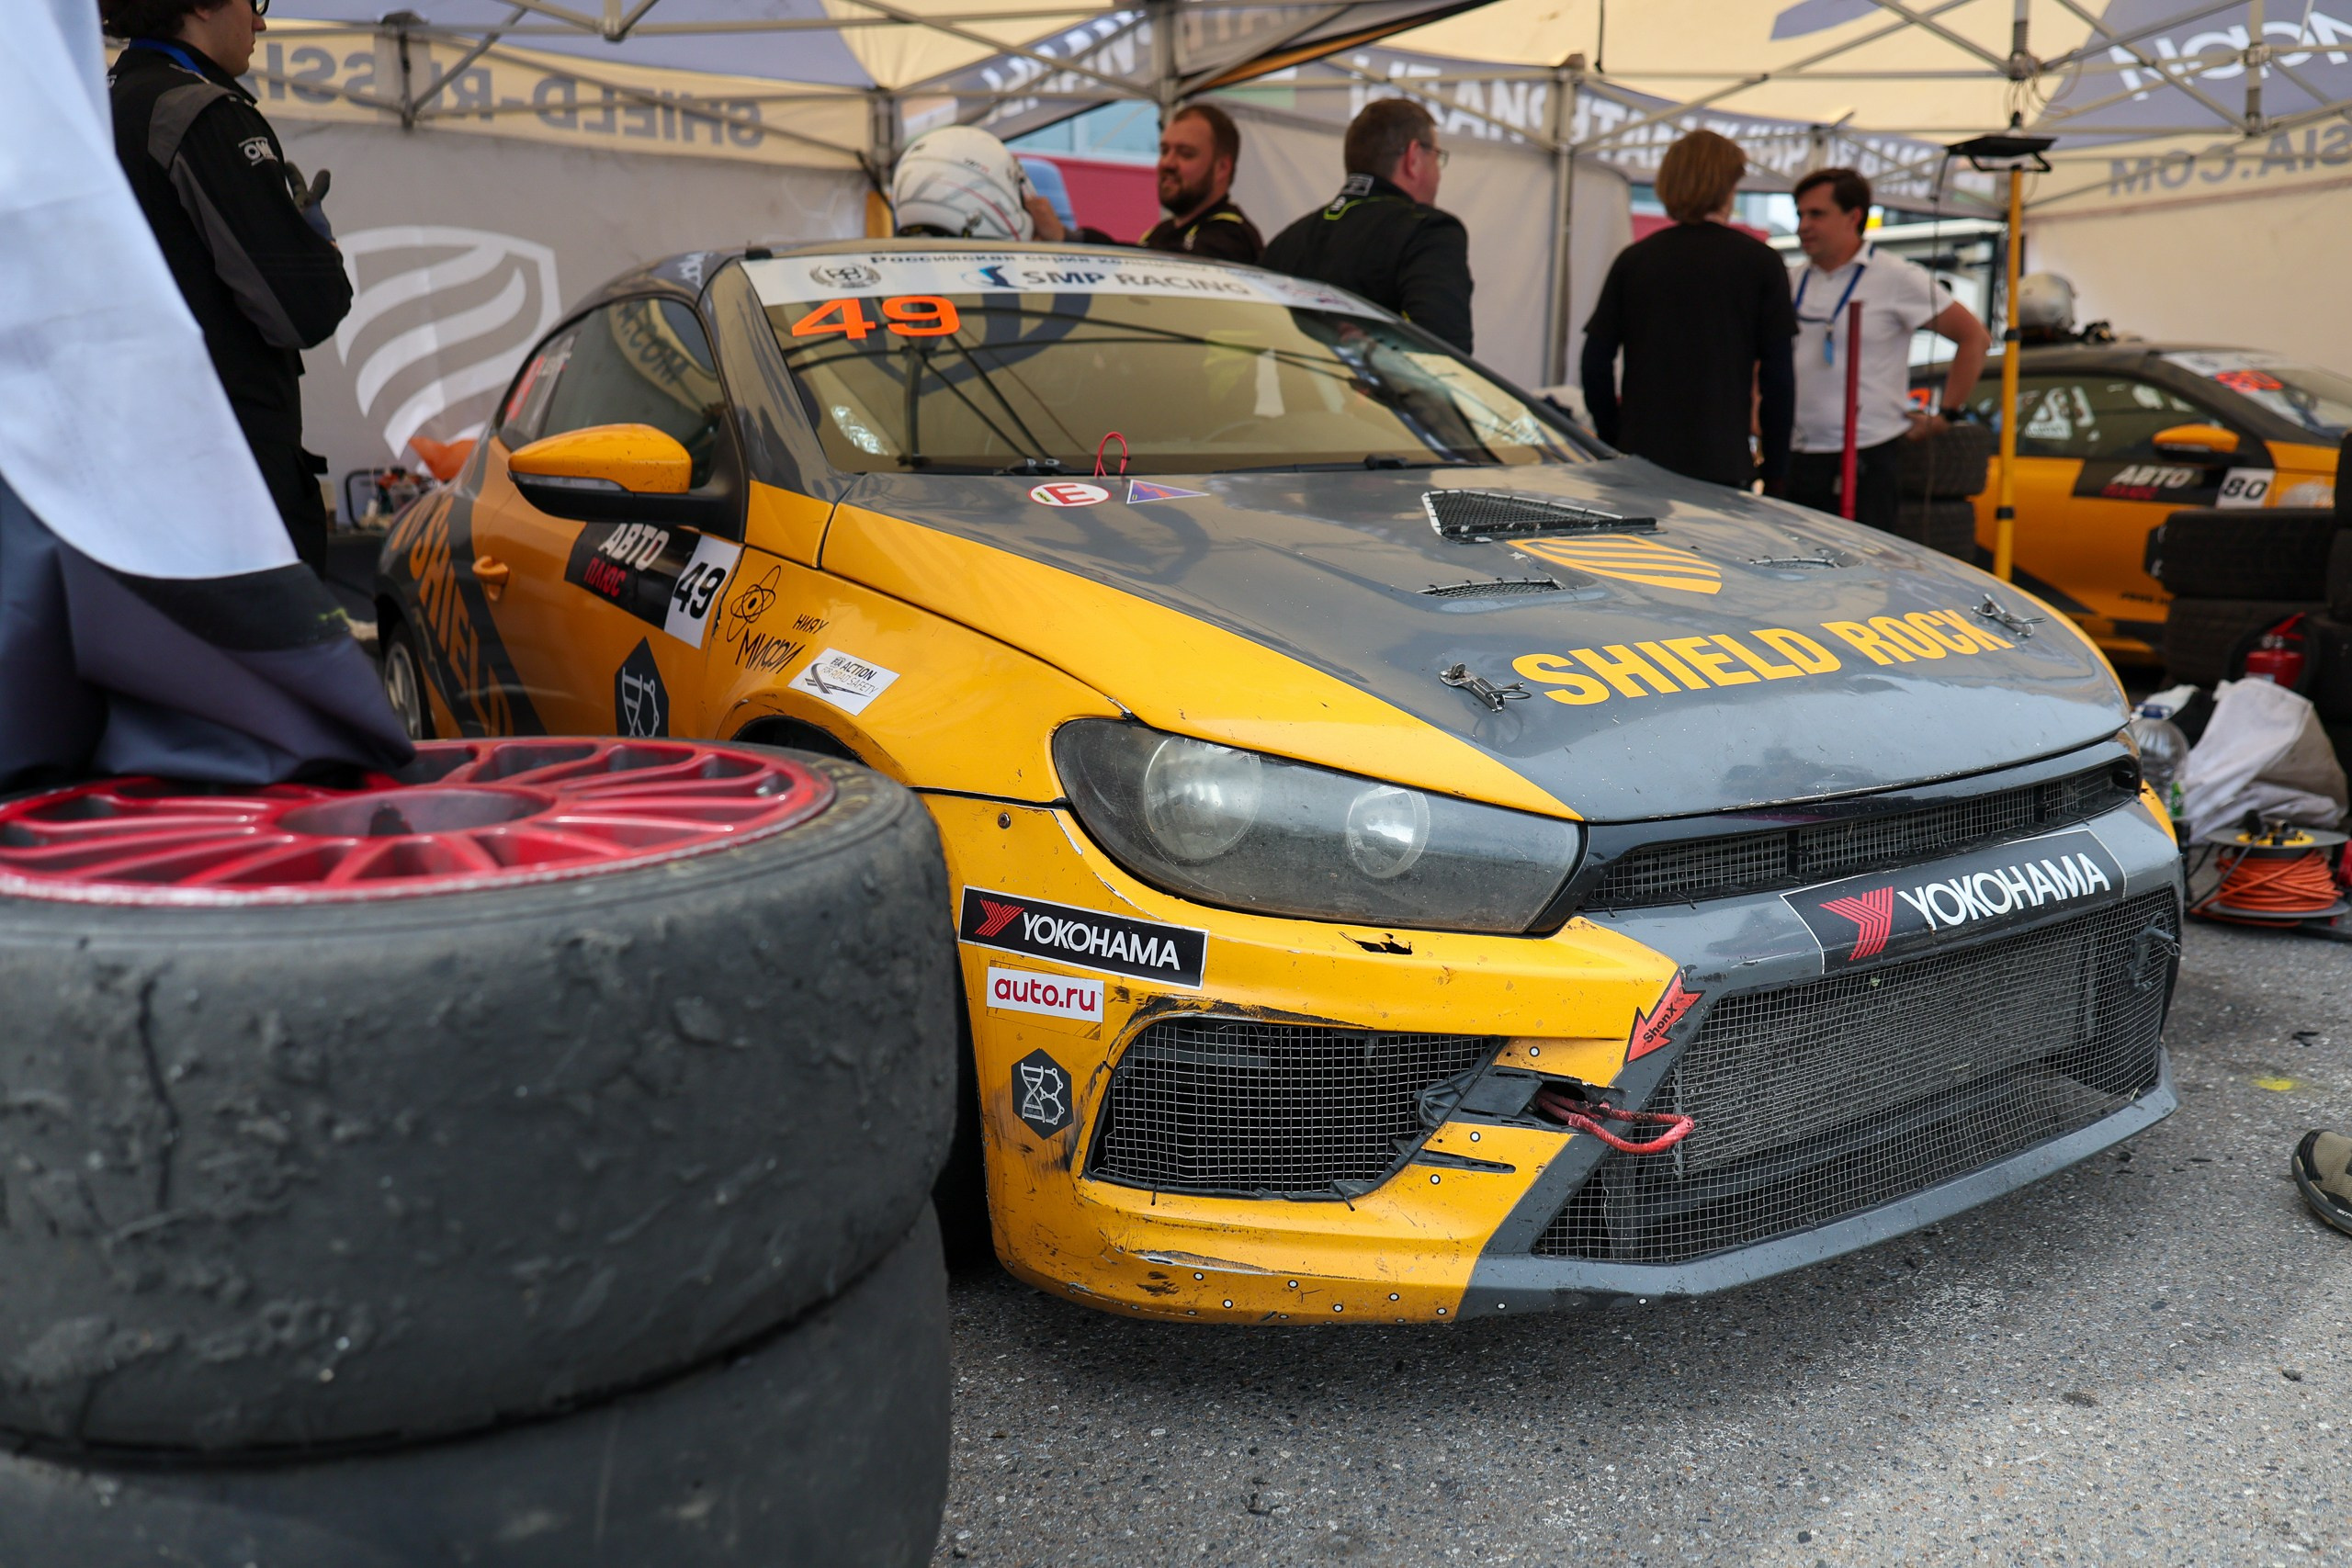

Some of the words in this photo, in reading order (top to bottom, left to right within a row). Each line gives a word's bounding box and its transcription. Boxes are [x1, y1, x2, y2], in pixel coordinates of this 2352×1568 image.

[1023, 271, 1105, 284] SMP
[1114, 273, 1251, 295] RACING
[791, 295, 960, 340] 49
[2223, 477, 2267, 500] 80
[598, 523, 670, 571] АВТО
[583, 557, 627, 597] ПЛЮС
[673, 561, 726, 619] 49
[792, 613, 829, 635] НИЯУ
[840, 661, 877, 681] ACTION
[1511, 627, 1842, 705] SHIELD
[1820, 608, 2016, 666] ROCK
[846, 677, 879, 694] SAFETY
[1897, 852, 2110, 931] YOKOHAMA
[1023, 911, 1182, 971] YOKOHAMA
[994, 977, 1096, 1012] auto.ru
[1643, 1002, 1678, 1043] ShonX
